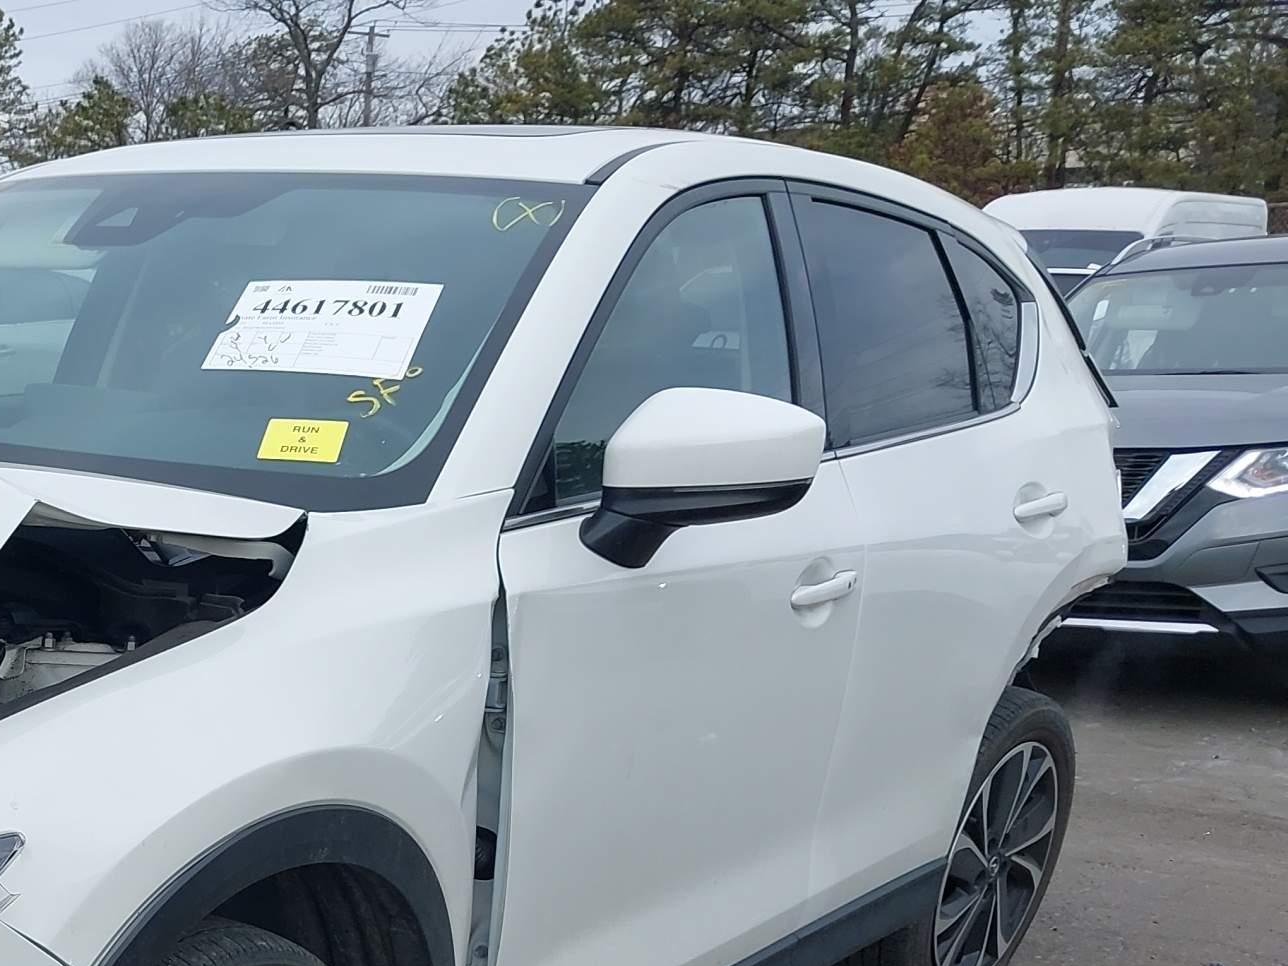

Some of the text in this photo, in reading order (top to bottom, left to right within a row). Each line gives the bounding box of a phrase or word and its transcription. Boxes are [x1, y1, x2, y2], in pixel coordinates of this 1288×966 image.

[253, 299, 403, 318] 44617801
[292, 426, 320, 434] RUN
[280, 446, 319, 454] DRIVE
